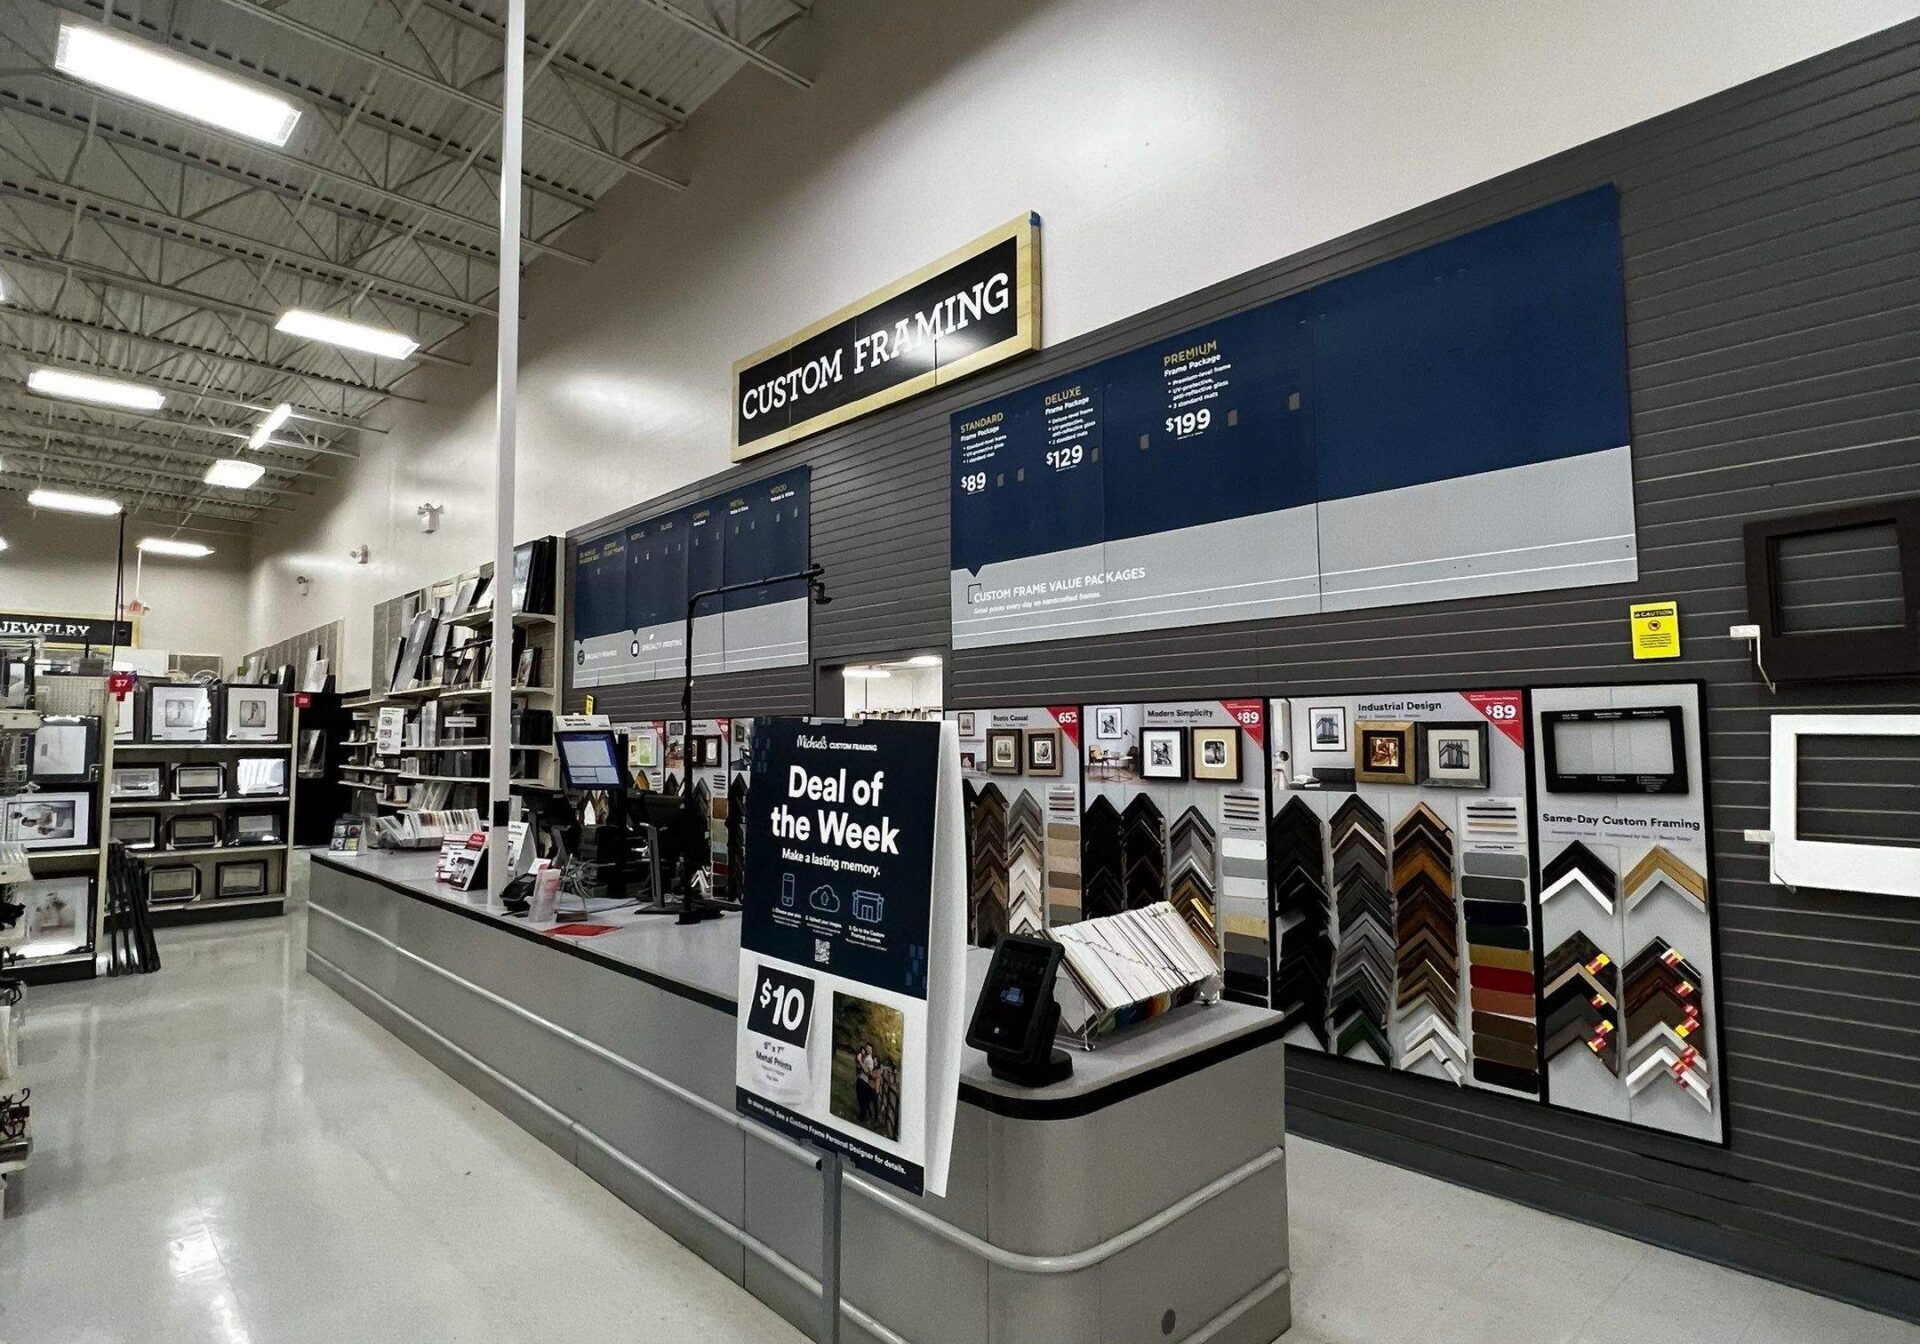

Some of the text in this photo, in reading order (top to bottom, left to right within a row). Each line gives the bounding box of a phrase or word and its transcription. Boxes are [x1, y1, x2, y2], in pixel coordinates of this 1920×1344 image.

[742, 272, 1009, 420] CUSTOM FRAMING
[1163, 340, 1217, 367] PREMIUM
[1164, 354, 1221, 377] Frame Package
[1044, 385, 1082, 407] DELUXE
[1045, 396, 1090, 416] Frame Package
[960, 412, 1004, 434] STANDARD
[1165, 408, 1211, 436] $199
[960, 425, 1000, 442] Frame Package
[1045, 444, 1083, 469] $129
[961, 471, 986, 492] $89
[974, 567, 1146, 604] CUSTOM FRAME VALUE PACKAGES
[1640, 609, 1673, 617] CAUTION
[0, 621, 90, 637] JEWELRY
[1147, 708, 1213, 718] Modern Simplicity
[1237, 711, 1260, 724] $89
[1358, 701, 1442, 712] Industrial Design
[1485, 704, 1517, 720] $89
[829, 742, 852, 750] CUSTOM
[852, 743, 878, 752] FRAMING
[788, 765, 885, 807] Deal of
[770, 804, 901, 855] the Week
[1542, 813, 1701, 831] Same-Day Custom Framing
[782, 848, 881, 878] Make a lasting memory.
[759, 978, 805, 1031] $10
[755, 1050, 773, 1065] Metal
[774, 1057, 793, 1072] Prints
[789, 1116, 809, 1131] Custom
[809, 1125, 825, 1139] Frame
[825, 1132, 849, 1149] Personal
[848, 1143, 874, 1160] Designer
[874, 1154, 884, 1165] for
[884, 1159, 907, 1175] details.
